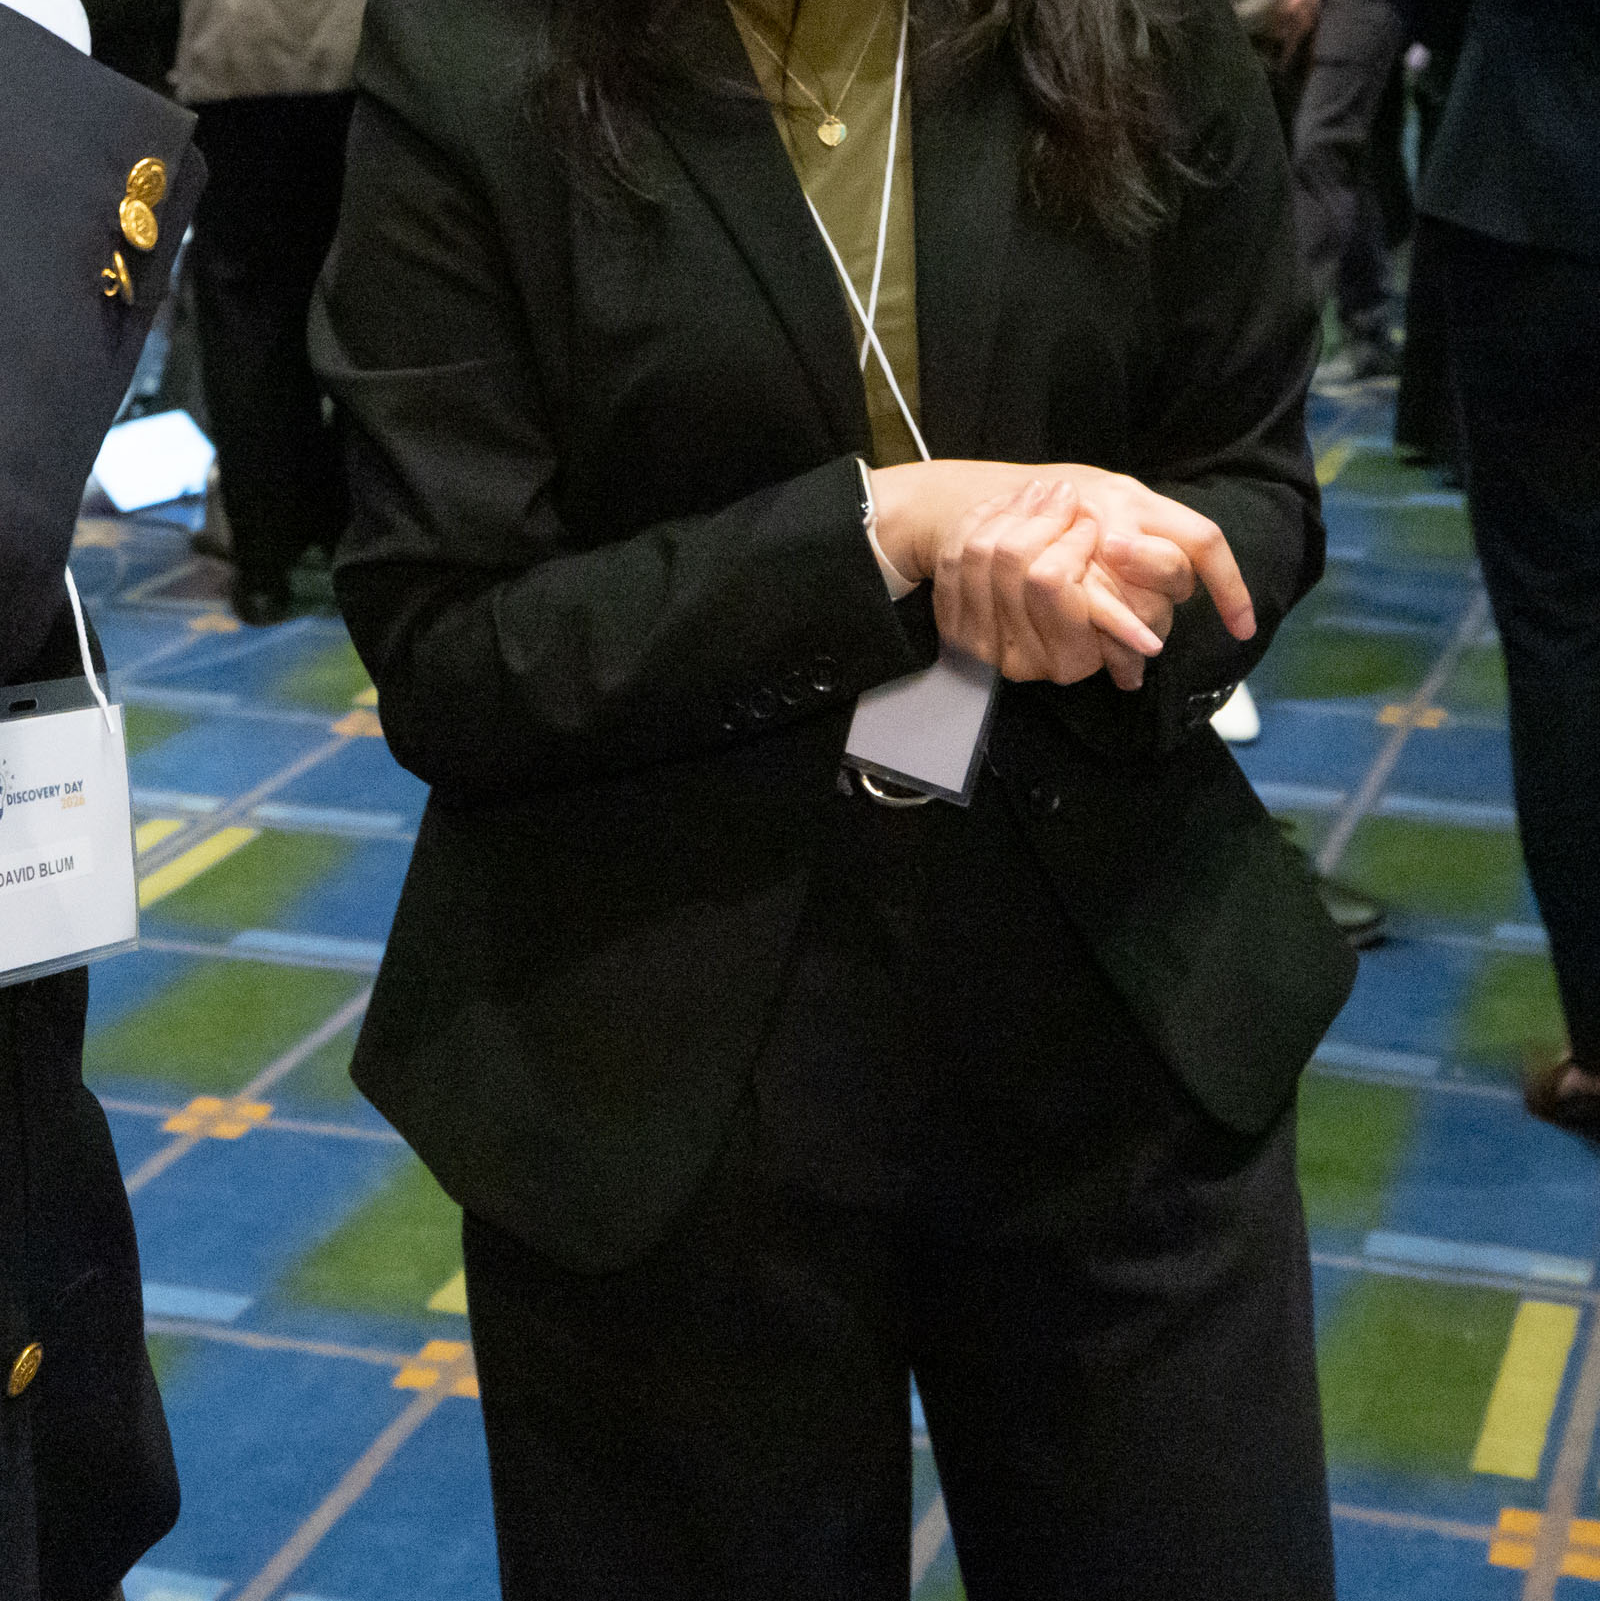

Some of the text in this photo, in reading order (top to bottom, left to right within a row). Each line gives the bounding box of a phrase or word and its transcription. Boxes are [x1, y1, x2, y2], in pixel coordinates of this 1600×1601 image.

[6, 779, 84, 806] DISCOVERY DAY
[39, 855, 75, 878] BLUM
